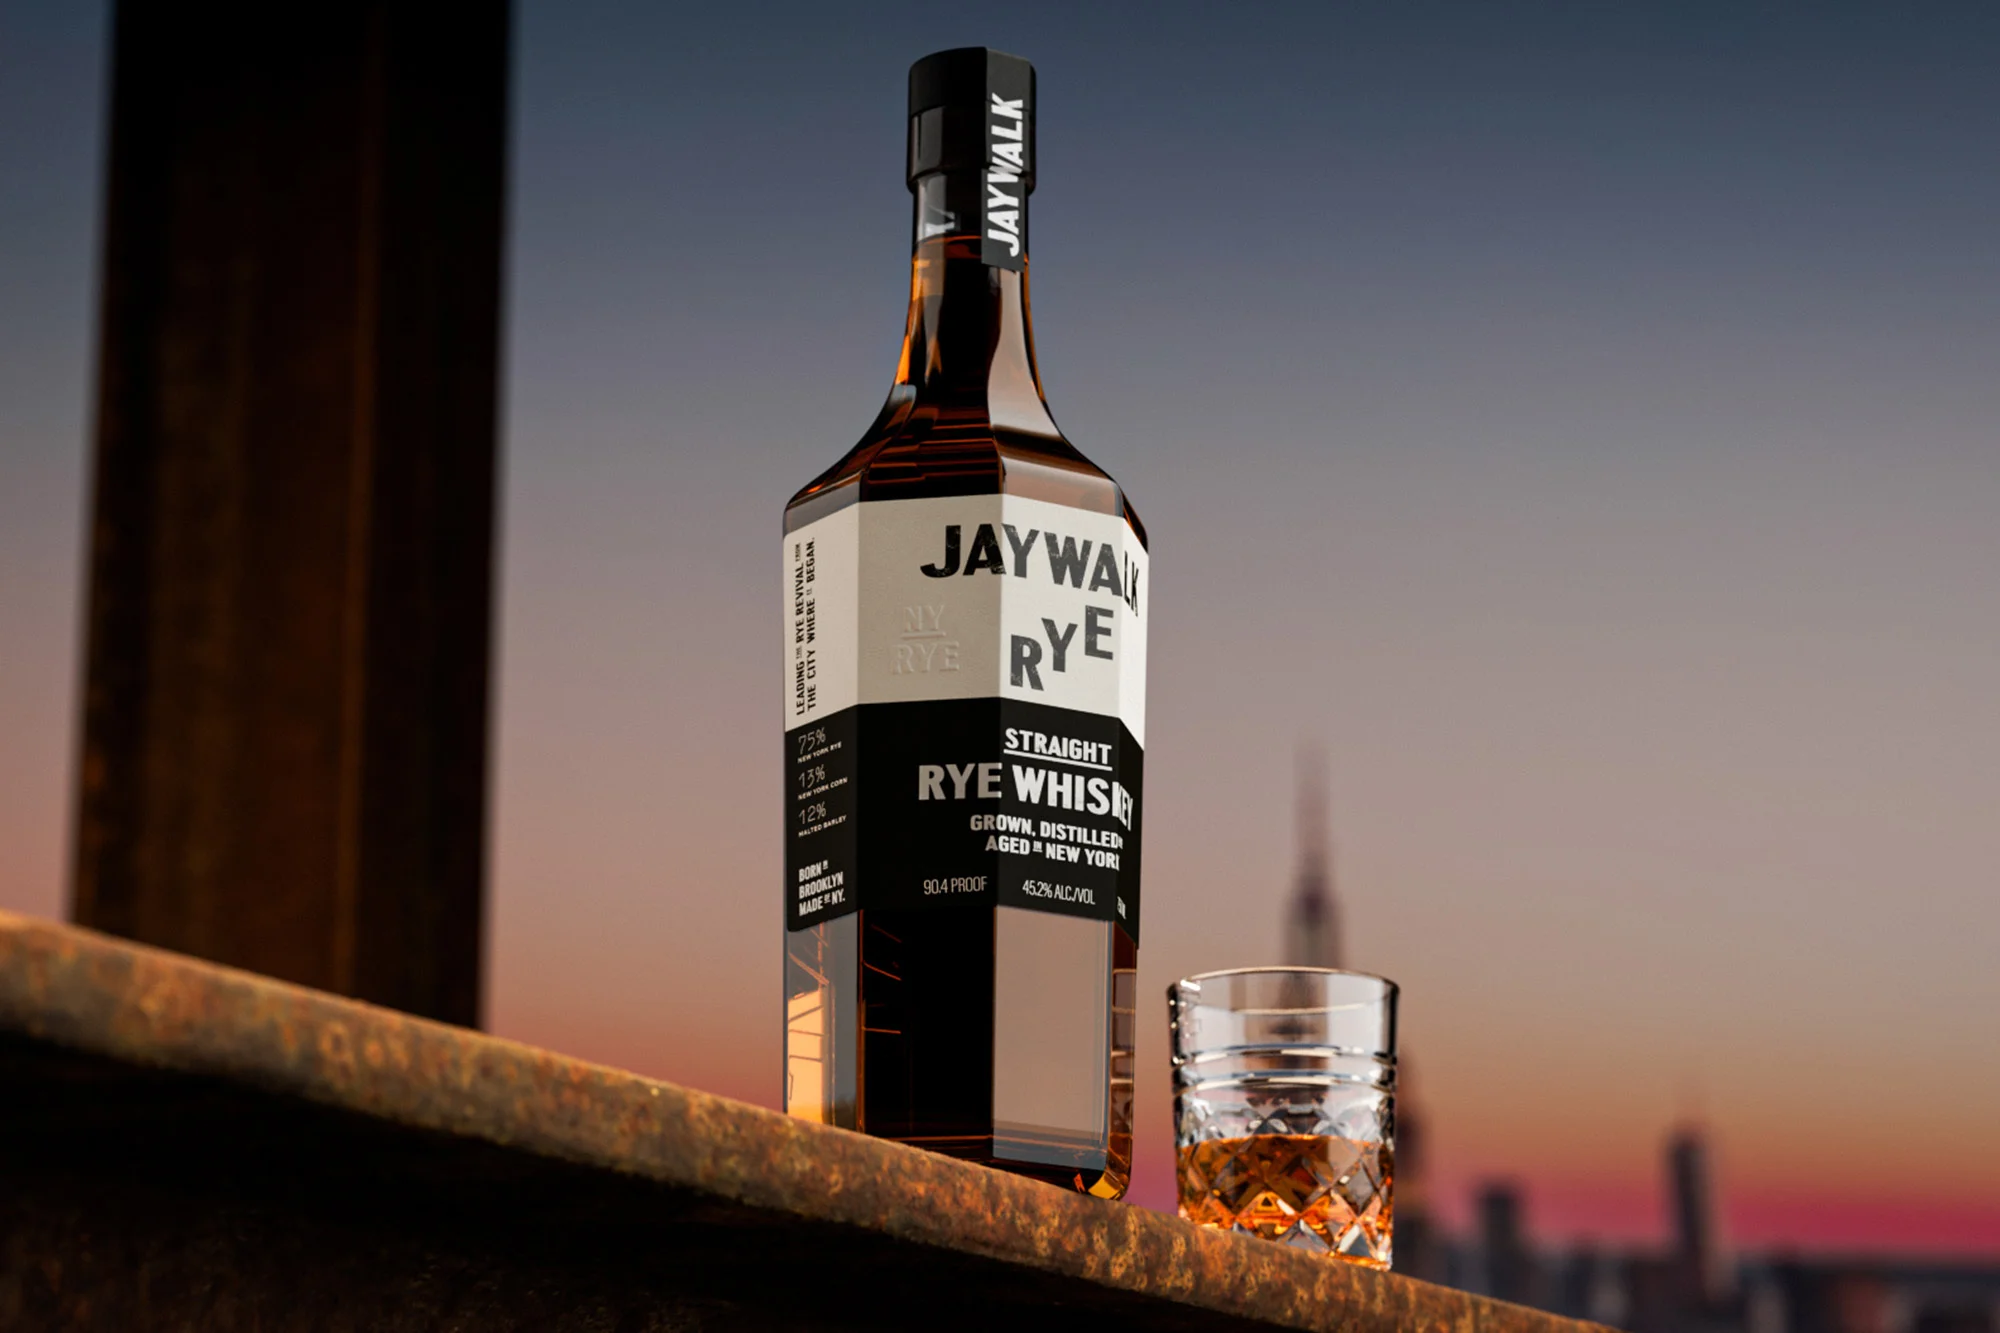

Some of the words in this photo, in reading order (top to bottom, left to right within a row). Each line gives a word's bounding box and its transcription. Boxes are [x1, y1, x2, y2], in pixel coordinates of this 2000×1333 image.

[988, 92, 1024, 257] JAYWALK
[806, 537, 815, 583] BEGAN.
[920, 523, 1140, 617] JAYWALK
[795, 563, 804, 616] REVIVAL
[796, 618, 804, 644] RYE
[806, 598, 815, 644] WHERE
[904, 604, 945, 632] NY
[890, 640, 960, 675] RYE
[1010, 605, 1115, 691] RYE
[807, 650, 816, 680] CITY
[796, 661, 805, 715] LEADING
[807, 684, 816, 712] THE
[797, 754, 812, 764] NEW
[813, 747, 829, 757] YORK
[830, 741, 842, 751] RYE
[798, 727, 826, 755] 75%
[1005, 727, 1112, 765] STRAIGHT
[798, 764, 825, 789] 13%
[798, 790, 812, 800] NEW
[813, 784, 829, 795] YORK
[830, 777, 848, 788] CORN
[918, 762, 1002, 800] RYE
[1012, 764, 1134, 831] WHISKEY
[798, 801, 826, 825] 12%
[798, 824, 822, 837] MALTED
[823, 815, 847, 828] BARLEY
[970, 814, 1036, 837] GROWN,
[1040, 820, 1119, 849] DISTILLED
[985, 835, 1031, 855] AGED
[1033, 840, 1043, 853] IN
[1045, 842, 1081, 863] NEW
[799, 861, 822, 883] BORN
[799, 871, 844, 900] BROOKLYN
[923, 877, 949, 895] 90.4
[950, 875, 988, 893] PROOF
[799, 895, 824, 916] MADE
[832, 888, 846, 906] NY.
[1022, 879, 1053, 899] 45.2%
